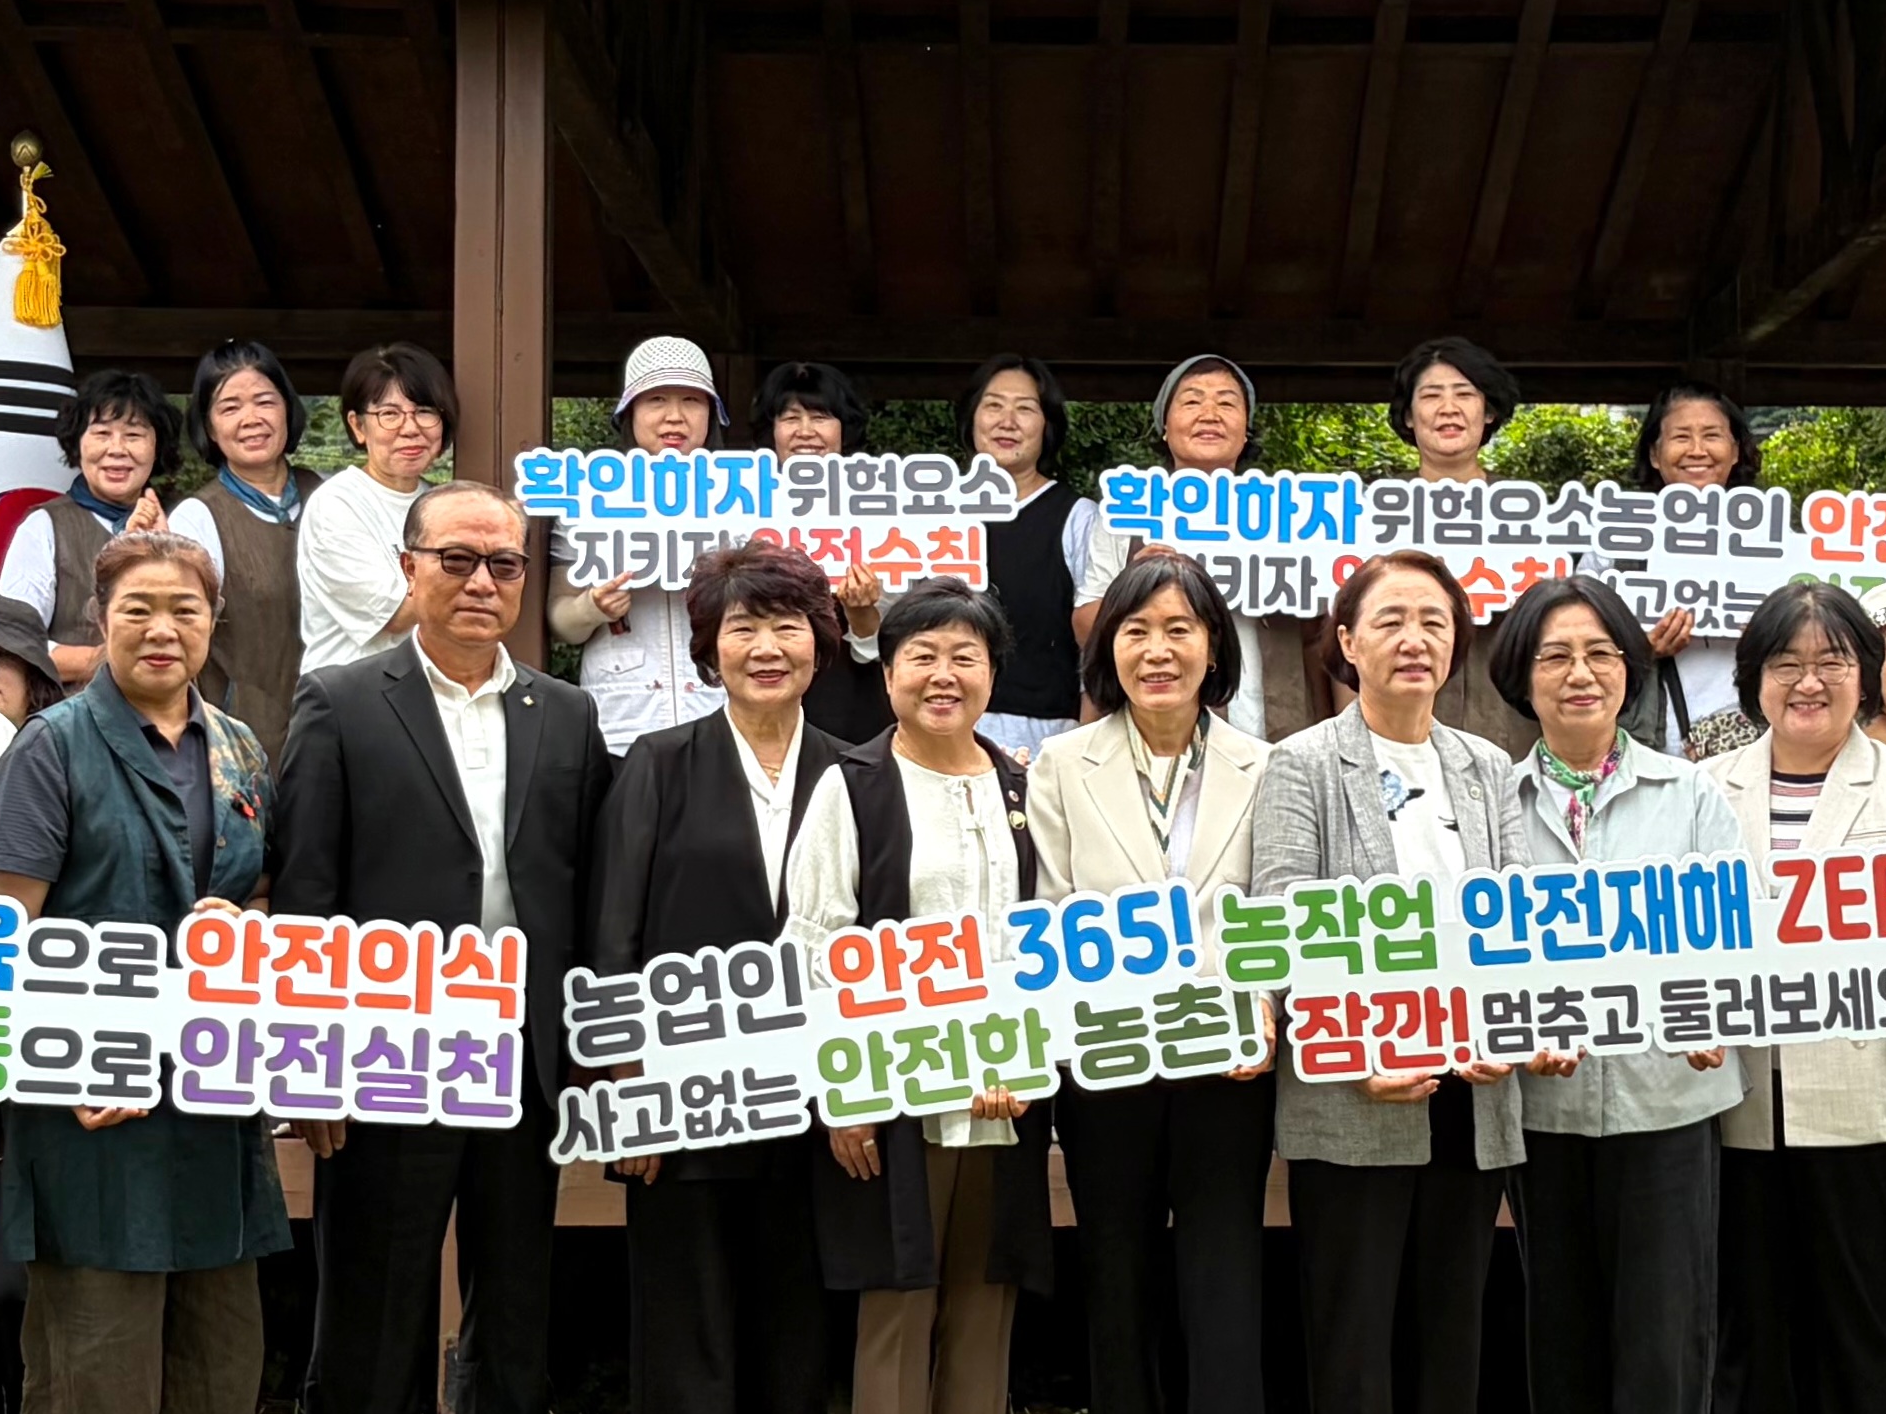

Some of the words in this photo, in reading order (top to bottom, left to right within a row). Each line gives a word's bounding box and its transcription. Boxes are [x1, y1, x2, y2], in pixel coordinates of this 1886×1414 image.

[519, 452, 779, 517] 확인하자
[789, 455, 1014, 517] 위험요소
[1106, 471, 1363, 544] 확인하자
[1371, 480, 1593, 548] 위험요소
[1599, 483, 1782, 555] 농업인
[1196, 553, 1318, 610] 키자
[184, 917, 518, 1019] 안전의식
[1221, 881, 1437, 984] 농작업
[1462, 859, 1752, 966] 안전재해
[570, 942, 806, 1059] 농업인
[828, 914, 989, 1019] 안전
[1006, 884, 1197, 992] 365!
[179, 1018, 513, 1119] 안전실천
[556, 1067, 804, 1156] 사고없는
[816, 1007, 1050, 1117] 안전한
[1074, 984, 1258, 1081] 농촌!
[1293, 985, 1473, 1076] 잠깐!
[1484, 983, 1644, 1057] 멈추고
